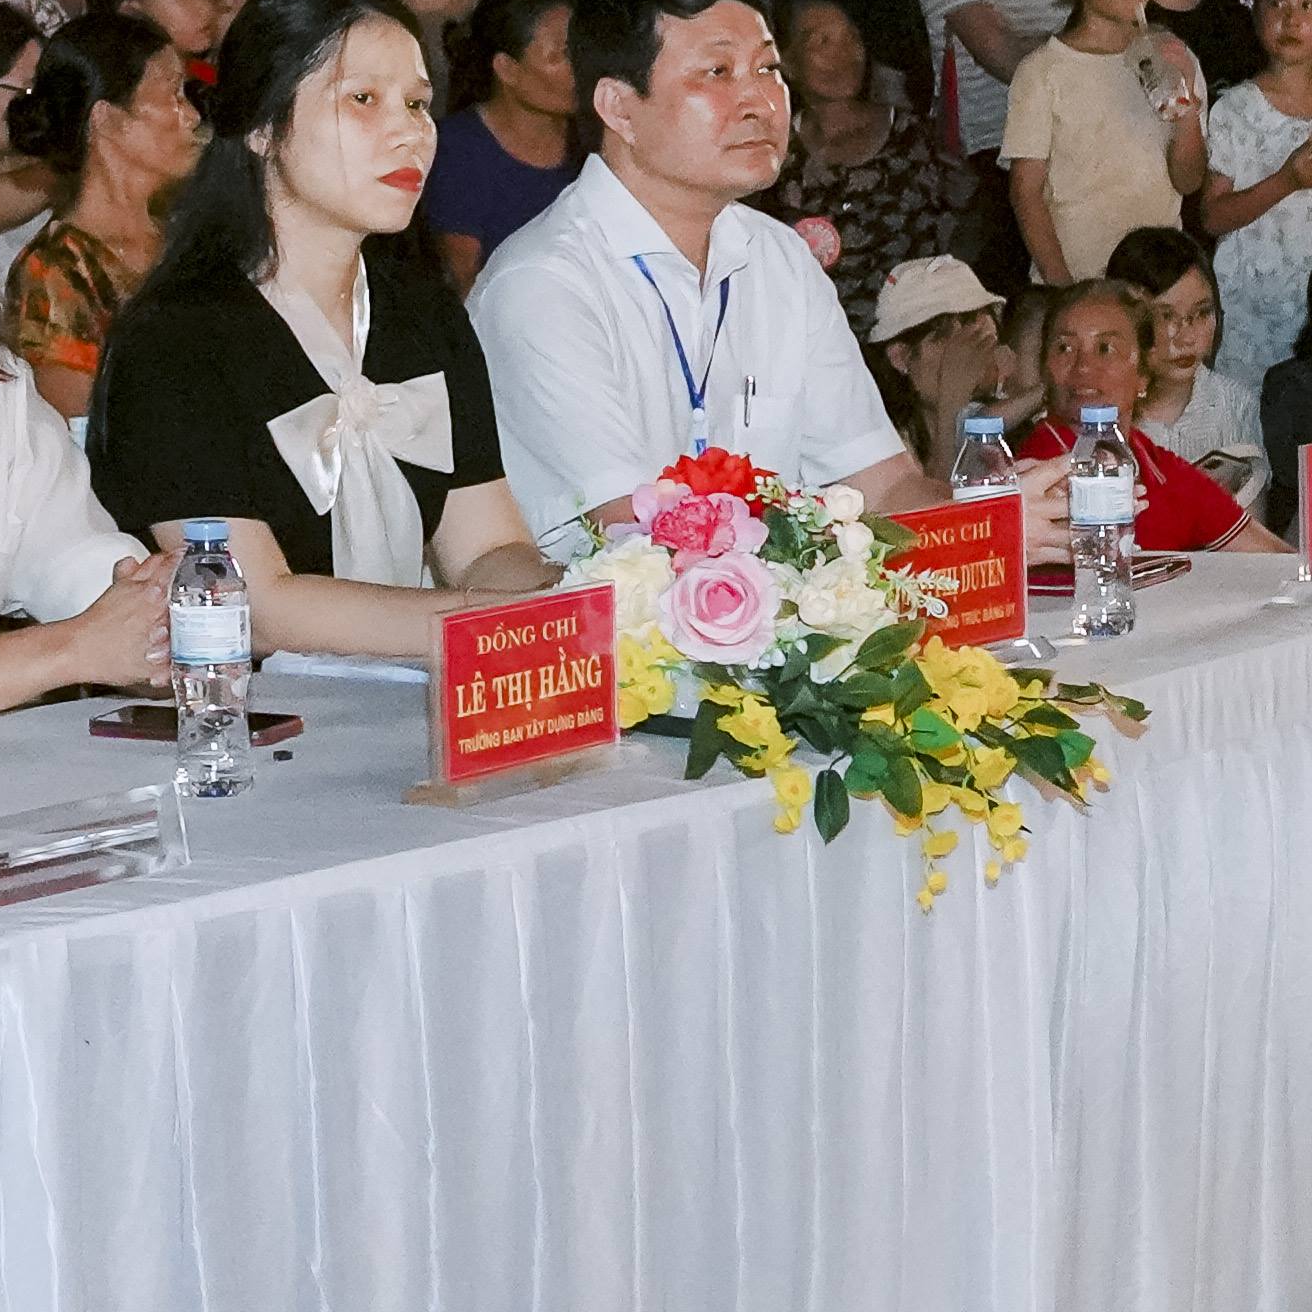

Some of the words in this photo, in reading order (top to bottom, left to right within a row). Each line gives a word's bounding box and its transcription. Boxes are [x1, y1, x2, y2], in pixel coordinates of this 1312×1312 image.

[917, 524, 955, 549] ỒNG
[960, 514, 992, 542] CHÍ
[476, 622, 537, 655] ĐỒNG
[542, 611, 578, 641] CHÍ
[456, 671, 487, 718] LÊ
[492, 669, 533, 711] THỊ
[539, 646, 604, 700] HẰNG
